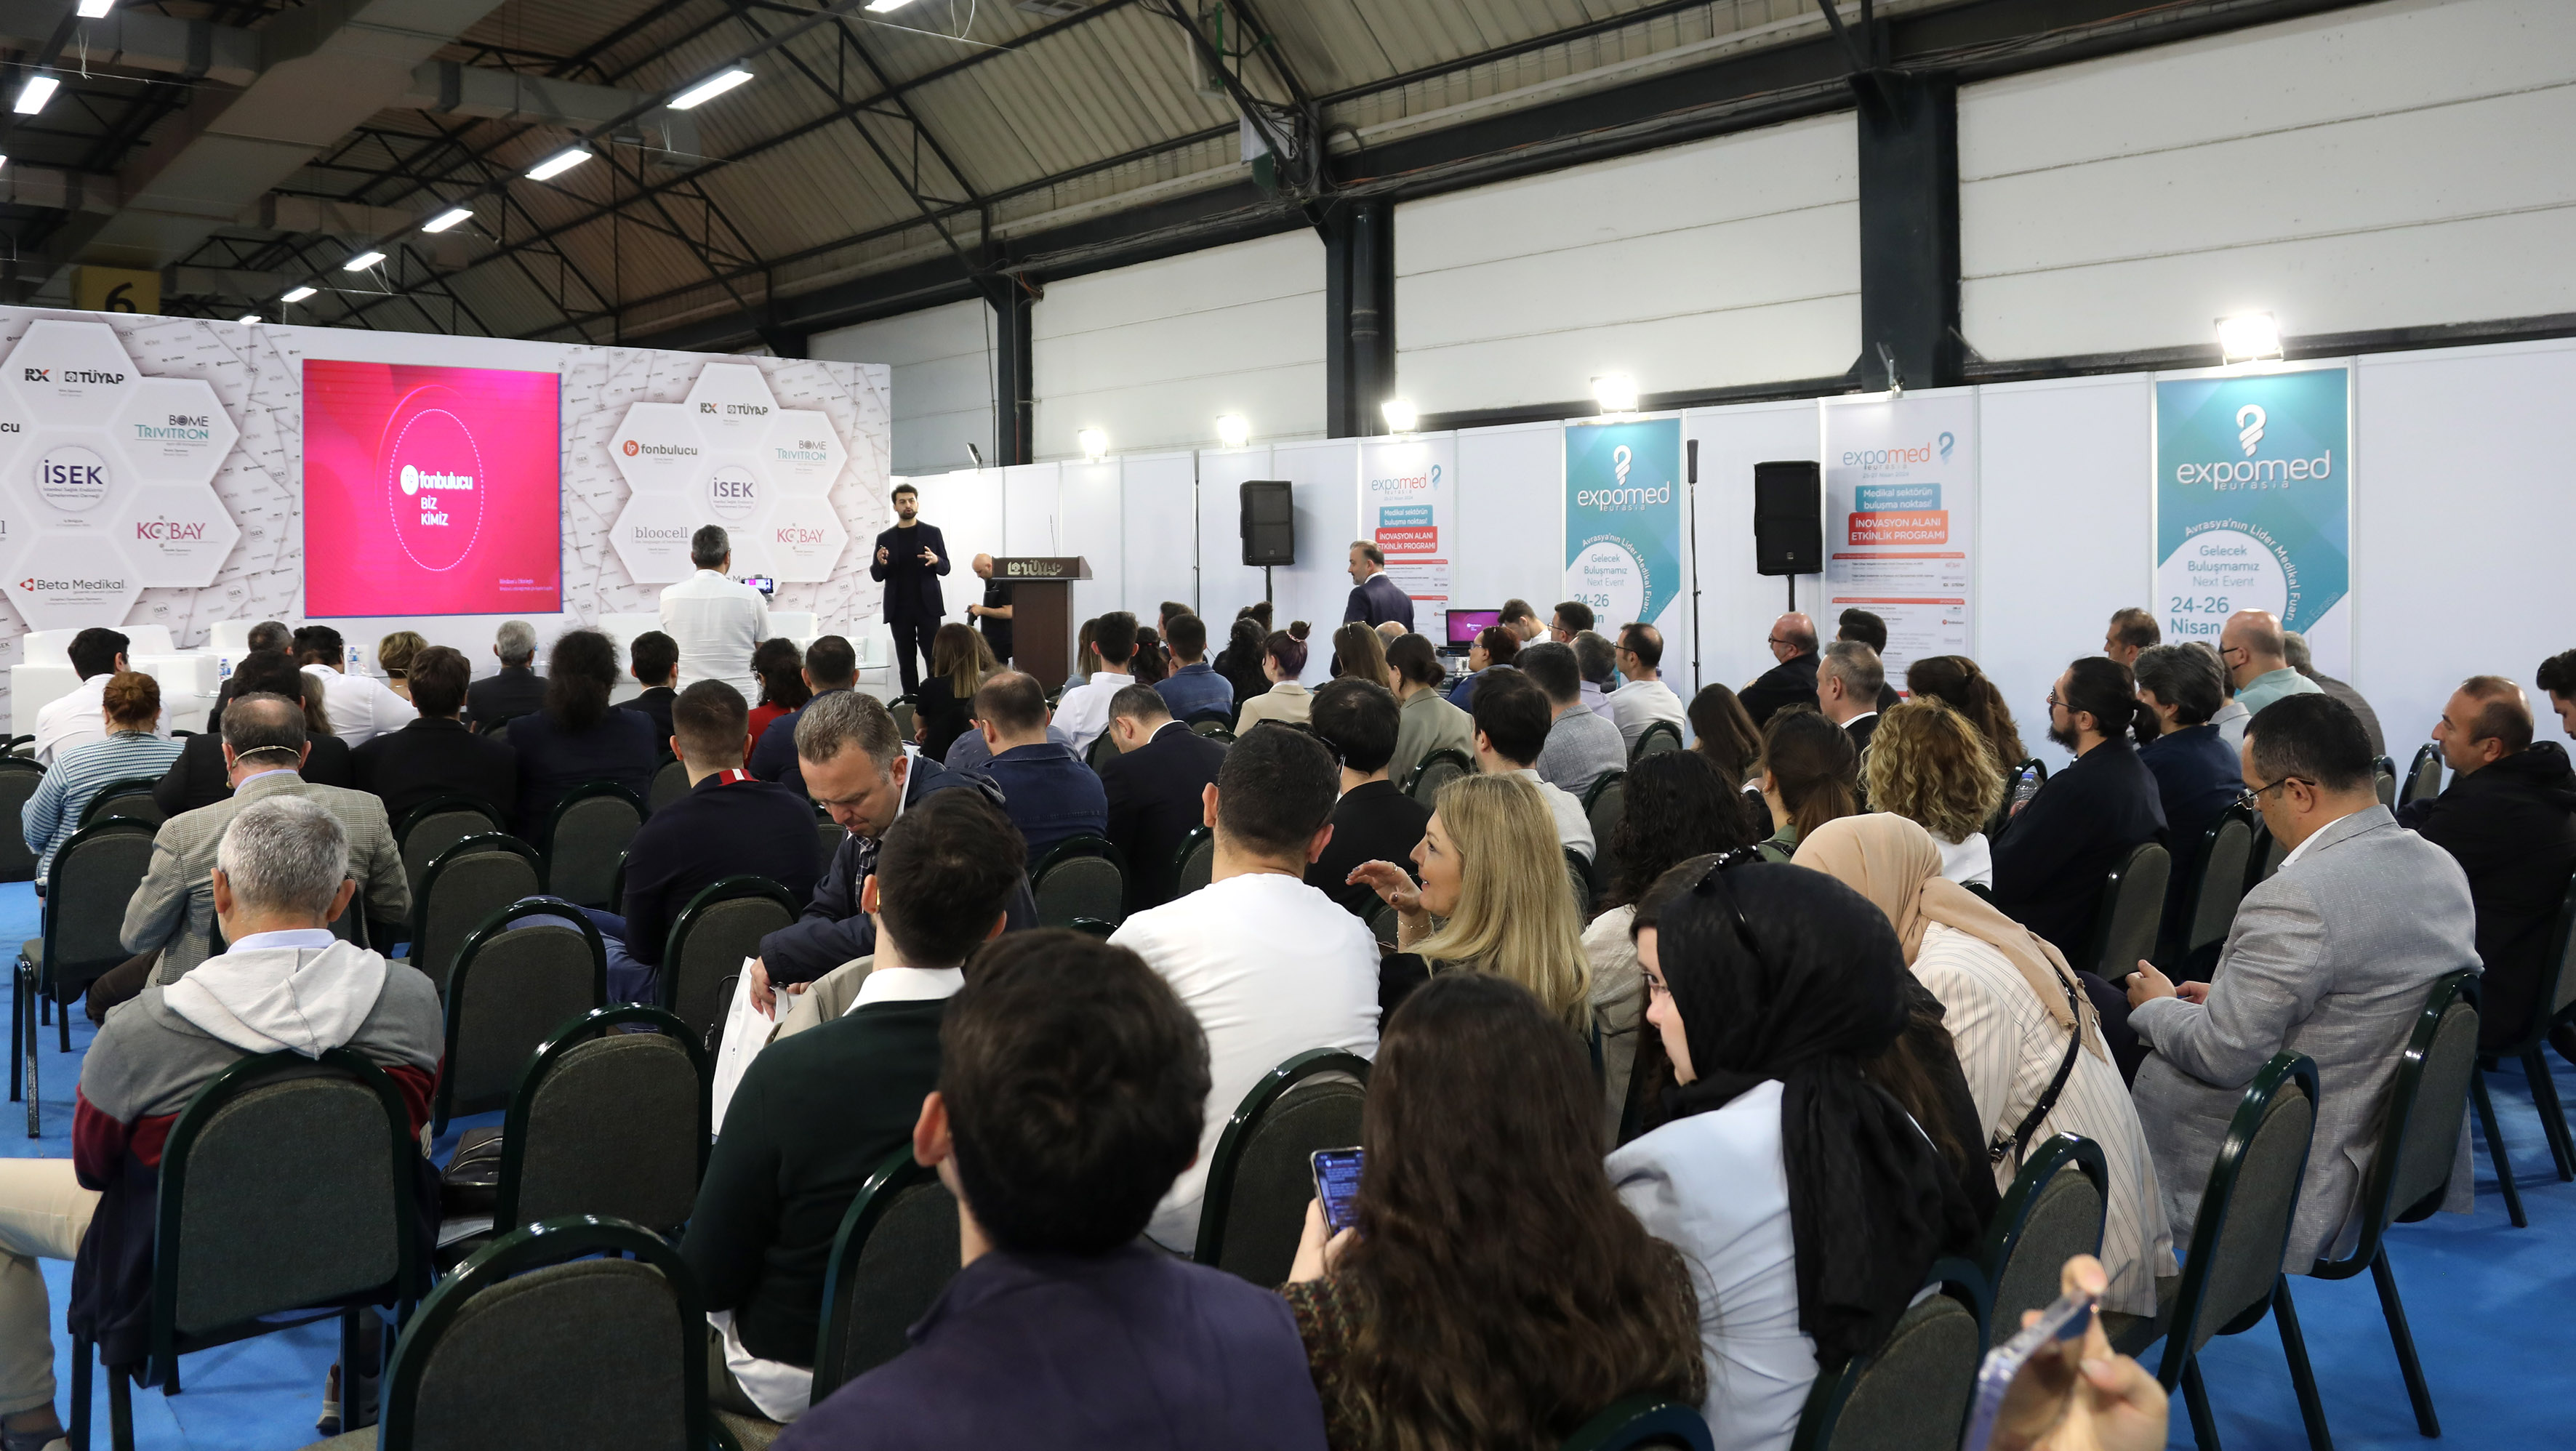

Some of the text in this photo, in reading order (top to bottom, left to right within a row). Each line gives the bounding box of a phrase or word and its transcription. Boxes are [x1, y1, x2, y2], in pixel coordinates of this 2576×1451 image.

[25, 368, 124, 385] RX TÜYAP
[700, 403, 768, 415] RX TÜYAP
[134, 424, 209, 439] TRIVITRON
[641, 444, 697, 456] fonbulucu
[775, 448, 827, 460] TRIVITRON
[1843, 442, 1930, 470] expomed
[44, 459, 103, 484] İSEK
[2176, 449, 2331, 491] expomed
[420, 470, 473, 489] fonbulucu
[1371, 472, 1427, 494] expomed
[2219, 481, 2289, 491] eurasia
[714, 478, 754, 497] İSEK
[1863, 487, 1933, 497] Medikal sektörün
[421, 494, 438, 510] BİZ
[1578, 481, 1670, 511] expomed
[1864, 499, 1932, 510] buluşma noktası!
[421, 510, 449, 526] KİMİZ
[1855, 518, 1941, 528] İNOVASYON ALANI
[635, 526, 688, 538] bloocell
[1851, 529, 1945, 541] ETKİNLİK PROGRAMI
[1621, 537, 1638, 555] Lider
[2200, 544, 2247, 556] Gelecek
[1592, 554, 1620, 563] Gelecek
[1022, 559, 1063, 576] TÜYAP
[1584, 566, 1627, 576] Buluşmamız
[1637, 554, 1653, 589] Medikal
[2185, 518, 2301, 621] Avrasya'nın Lider Medikal Fuarı
[2188, 560, 2260, 575] Buluşmamız
[37, 579, 124, 590] Beta Medikal
[1587, 578, 1603, 587] Next
[2193, 576, 2254, 587] Next Event
[1642, 590, 1652, 614] Fuarı
[2171, 597, 2229, 614] 24-26
[2171, 618, 2220, 634] Nisan
